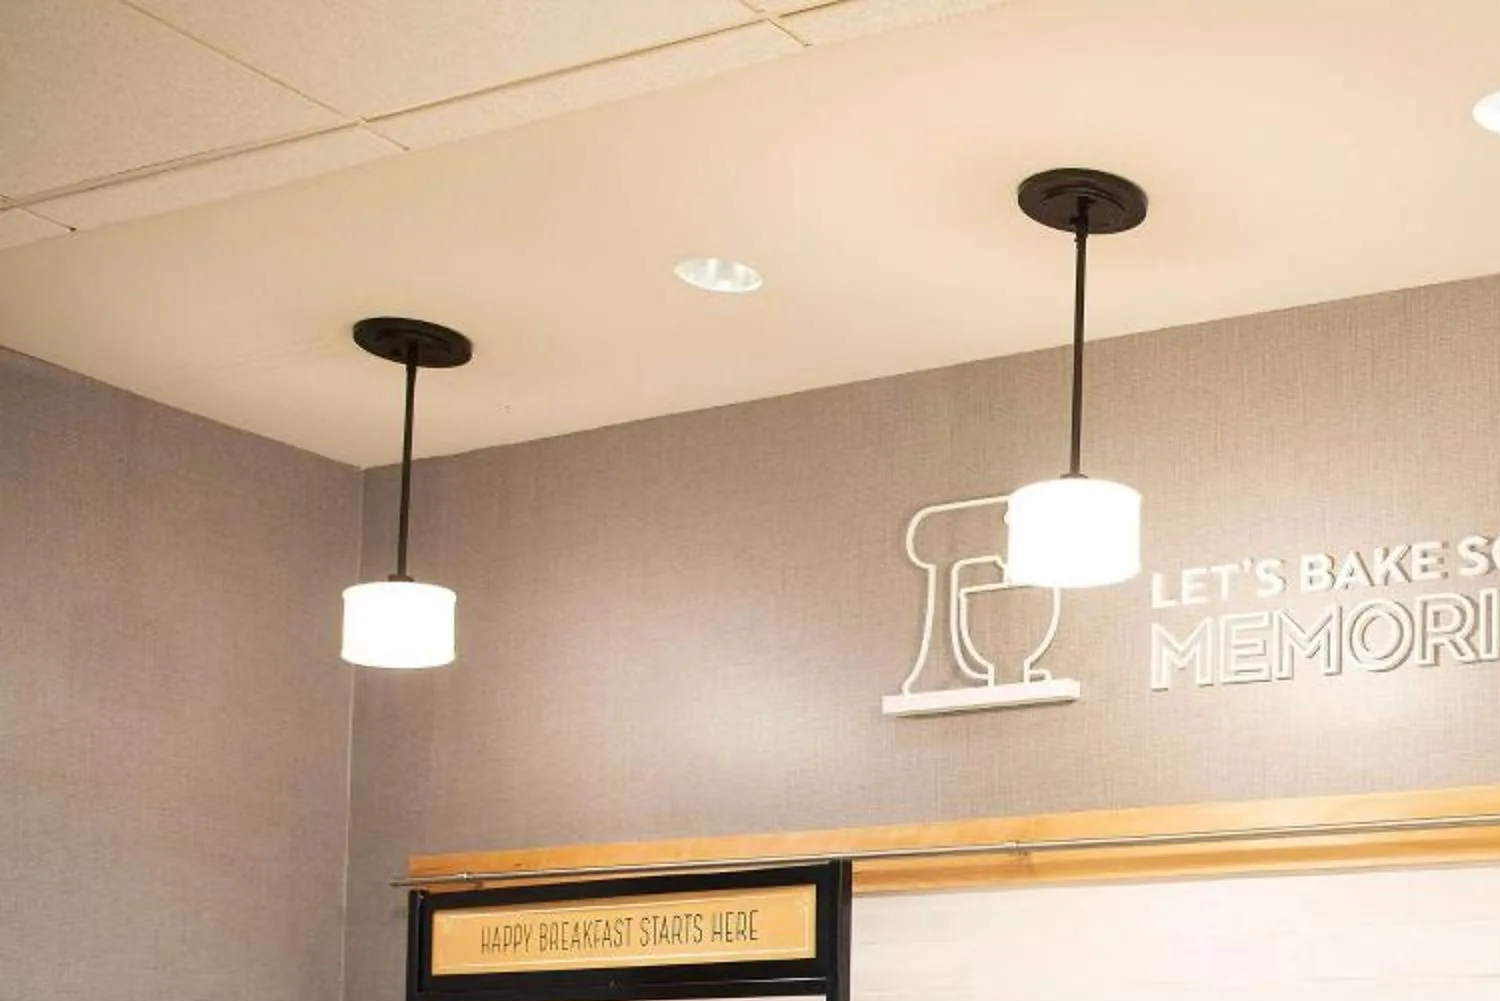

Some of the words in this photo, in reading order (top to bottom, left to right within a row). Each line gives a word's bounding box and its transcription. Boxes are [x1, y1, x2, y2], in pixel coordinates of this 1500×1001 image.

[1151, 558, 1285, 609] LET'S
[1300, 541, 1446, 593] BAKE
[481, 922, 533, 955] HAPPY
[539, 917, 633, 952] BREAKFAST
[639, 913, 703, 948] STARTS
[711, 910, 759, 943] HERE
